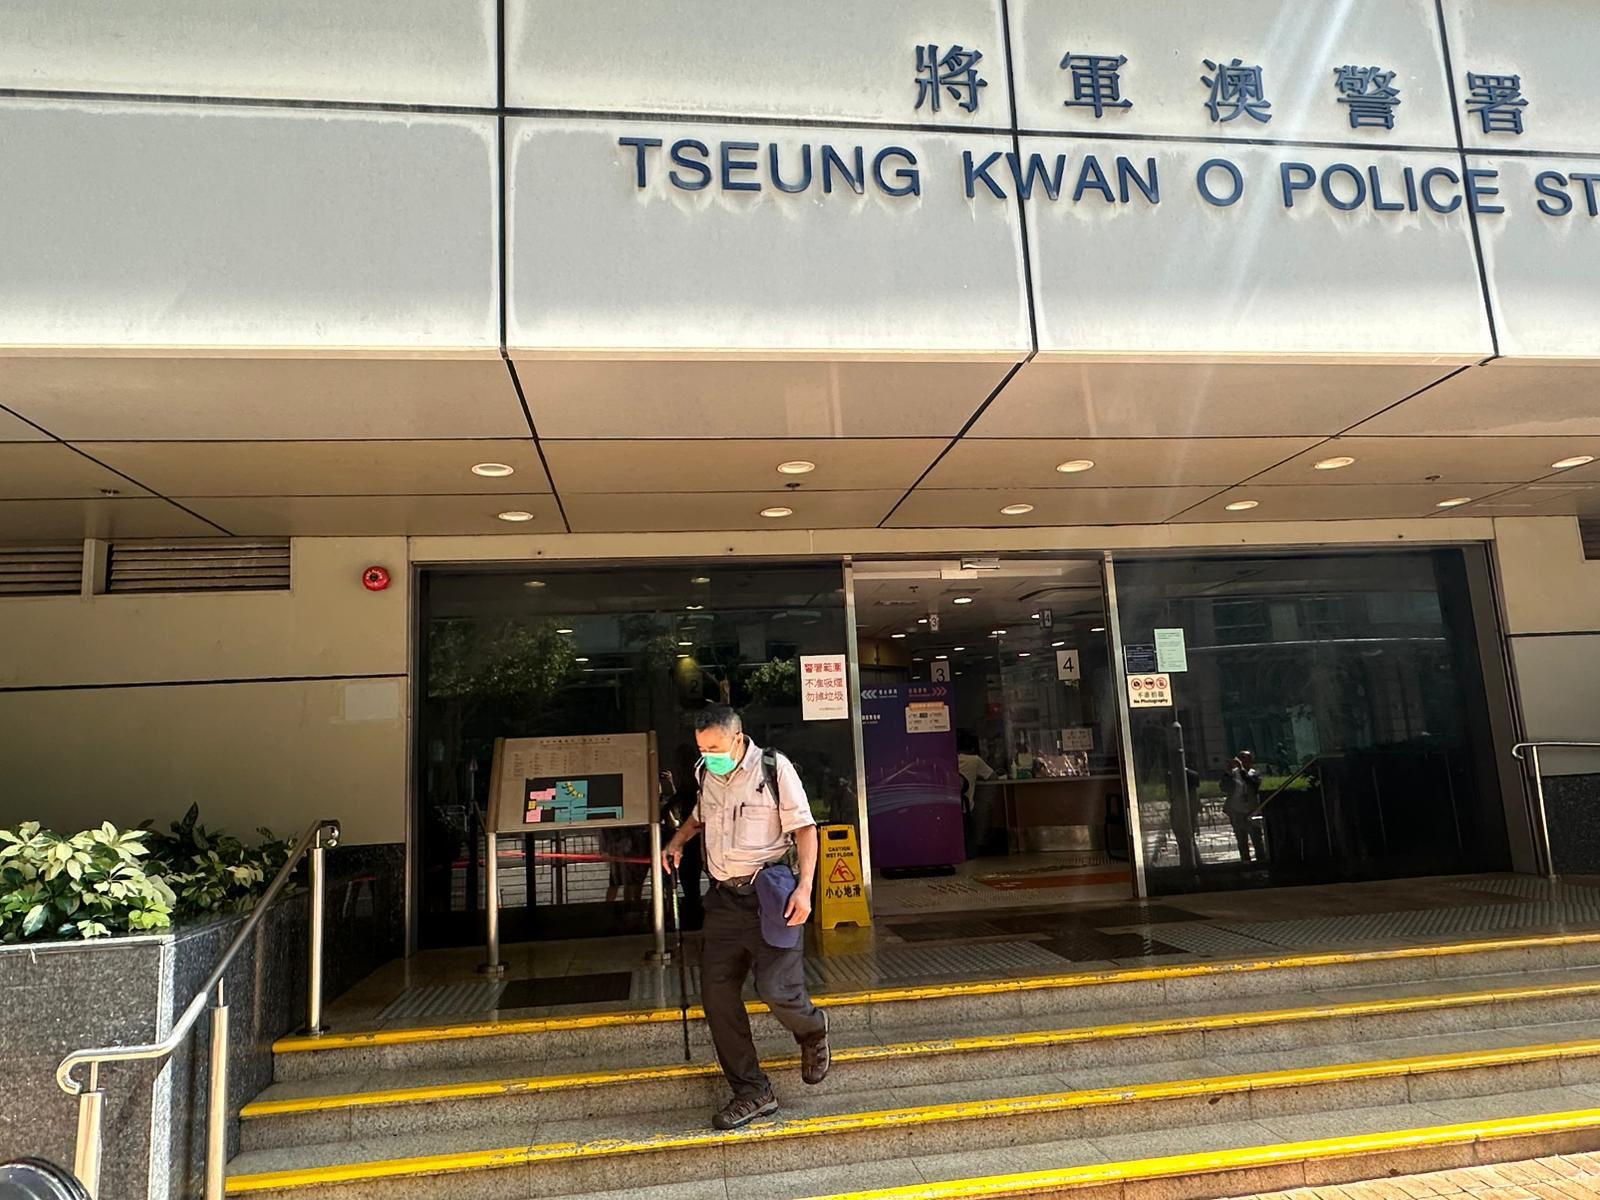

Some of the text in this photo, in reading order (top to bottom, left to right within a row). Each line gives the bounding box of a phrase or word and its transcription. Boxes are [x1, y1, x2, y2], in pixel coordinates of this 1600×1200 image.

[914, 43, 1529, 135] 將軍澳警署
[618, 137, 1600, 216] TSEUNG KWAN O POLICE ST
[1063, 657, 1074, 673] 4
[935, 667, 945, 682] 3
[826, 885, 861, 898] 小心地滑
